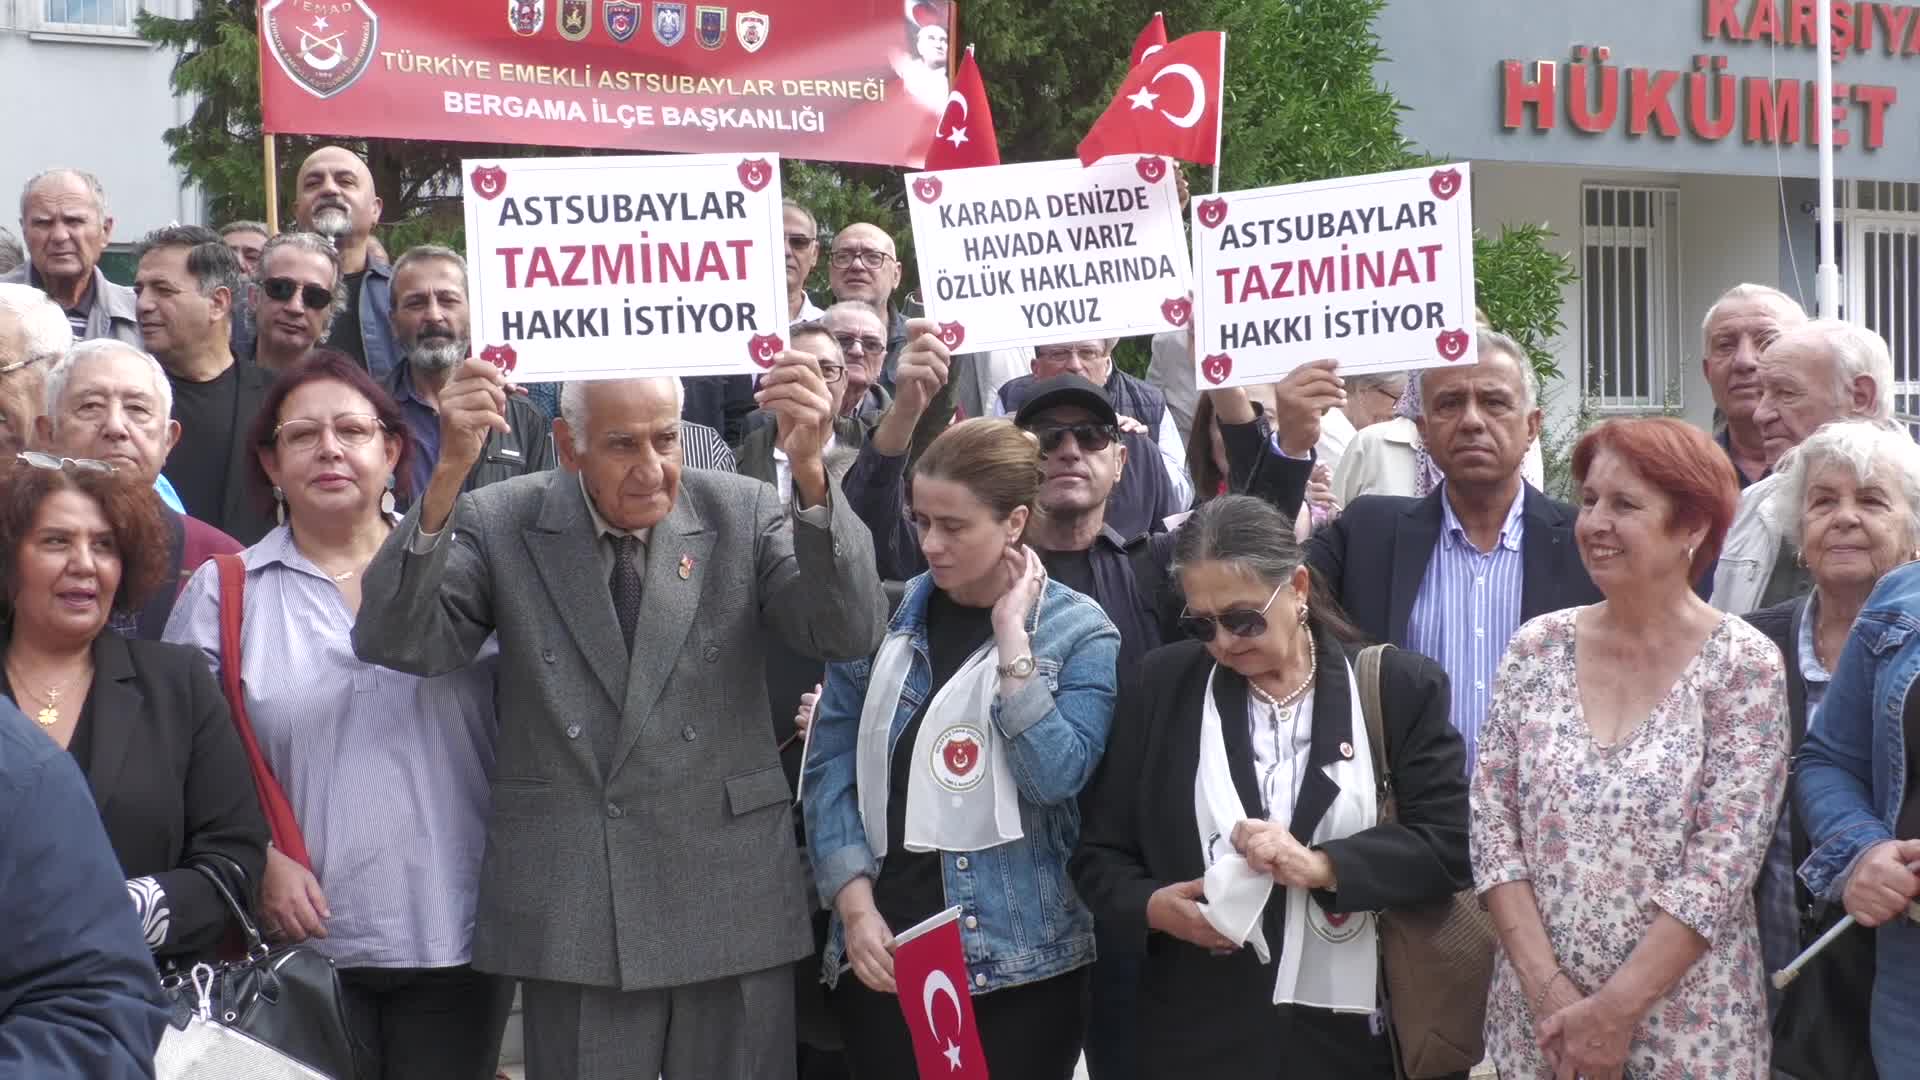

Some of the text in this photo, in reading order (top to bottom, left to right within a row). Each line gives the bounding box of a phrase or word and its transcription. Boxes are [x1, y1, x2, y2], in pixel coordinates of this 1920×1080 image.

[1702, 0, 1920, 62] KARŞIY
[380, 50, 886, 102] TÜRKİYE EMEKLİ ASTSUBAYLAR DERNEĞİ
[1501, 45, 1897, 149] HÜKÜMET
[443, 90, 825, 133] BERGAMA İLÇE BAŞKANLIĞI
[498, 190, 747, 226] ASTSUBAYLAR
[939, 184, 1149, 229] KARADA DENİZDE
[1219, 200, 1437, 250] ASTSUBAYLAR
[495, 231, 753, 288] TAZMİNAT
[963, 222, 1137, 262] HAVADA VARIZ
[936, 254, 1176, 301] ÖZLÜK HAKLARINDA
[1216, 244, 1443, 304] TAZMİNAT
[502, 296, 758, 340] HAKKI İSTİYOR
[1021, 298, 1101, 329] YOKUZ
[1220, 300, 1446, 350] HAKKI İSTİYOR
